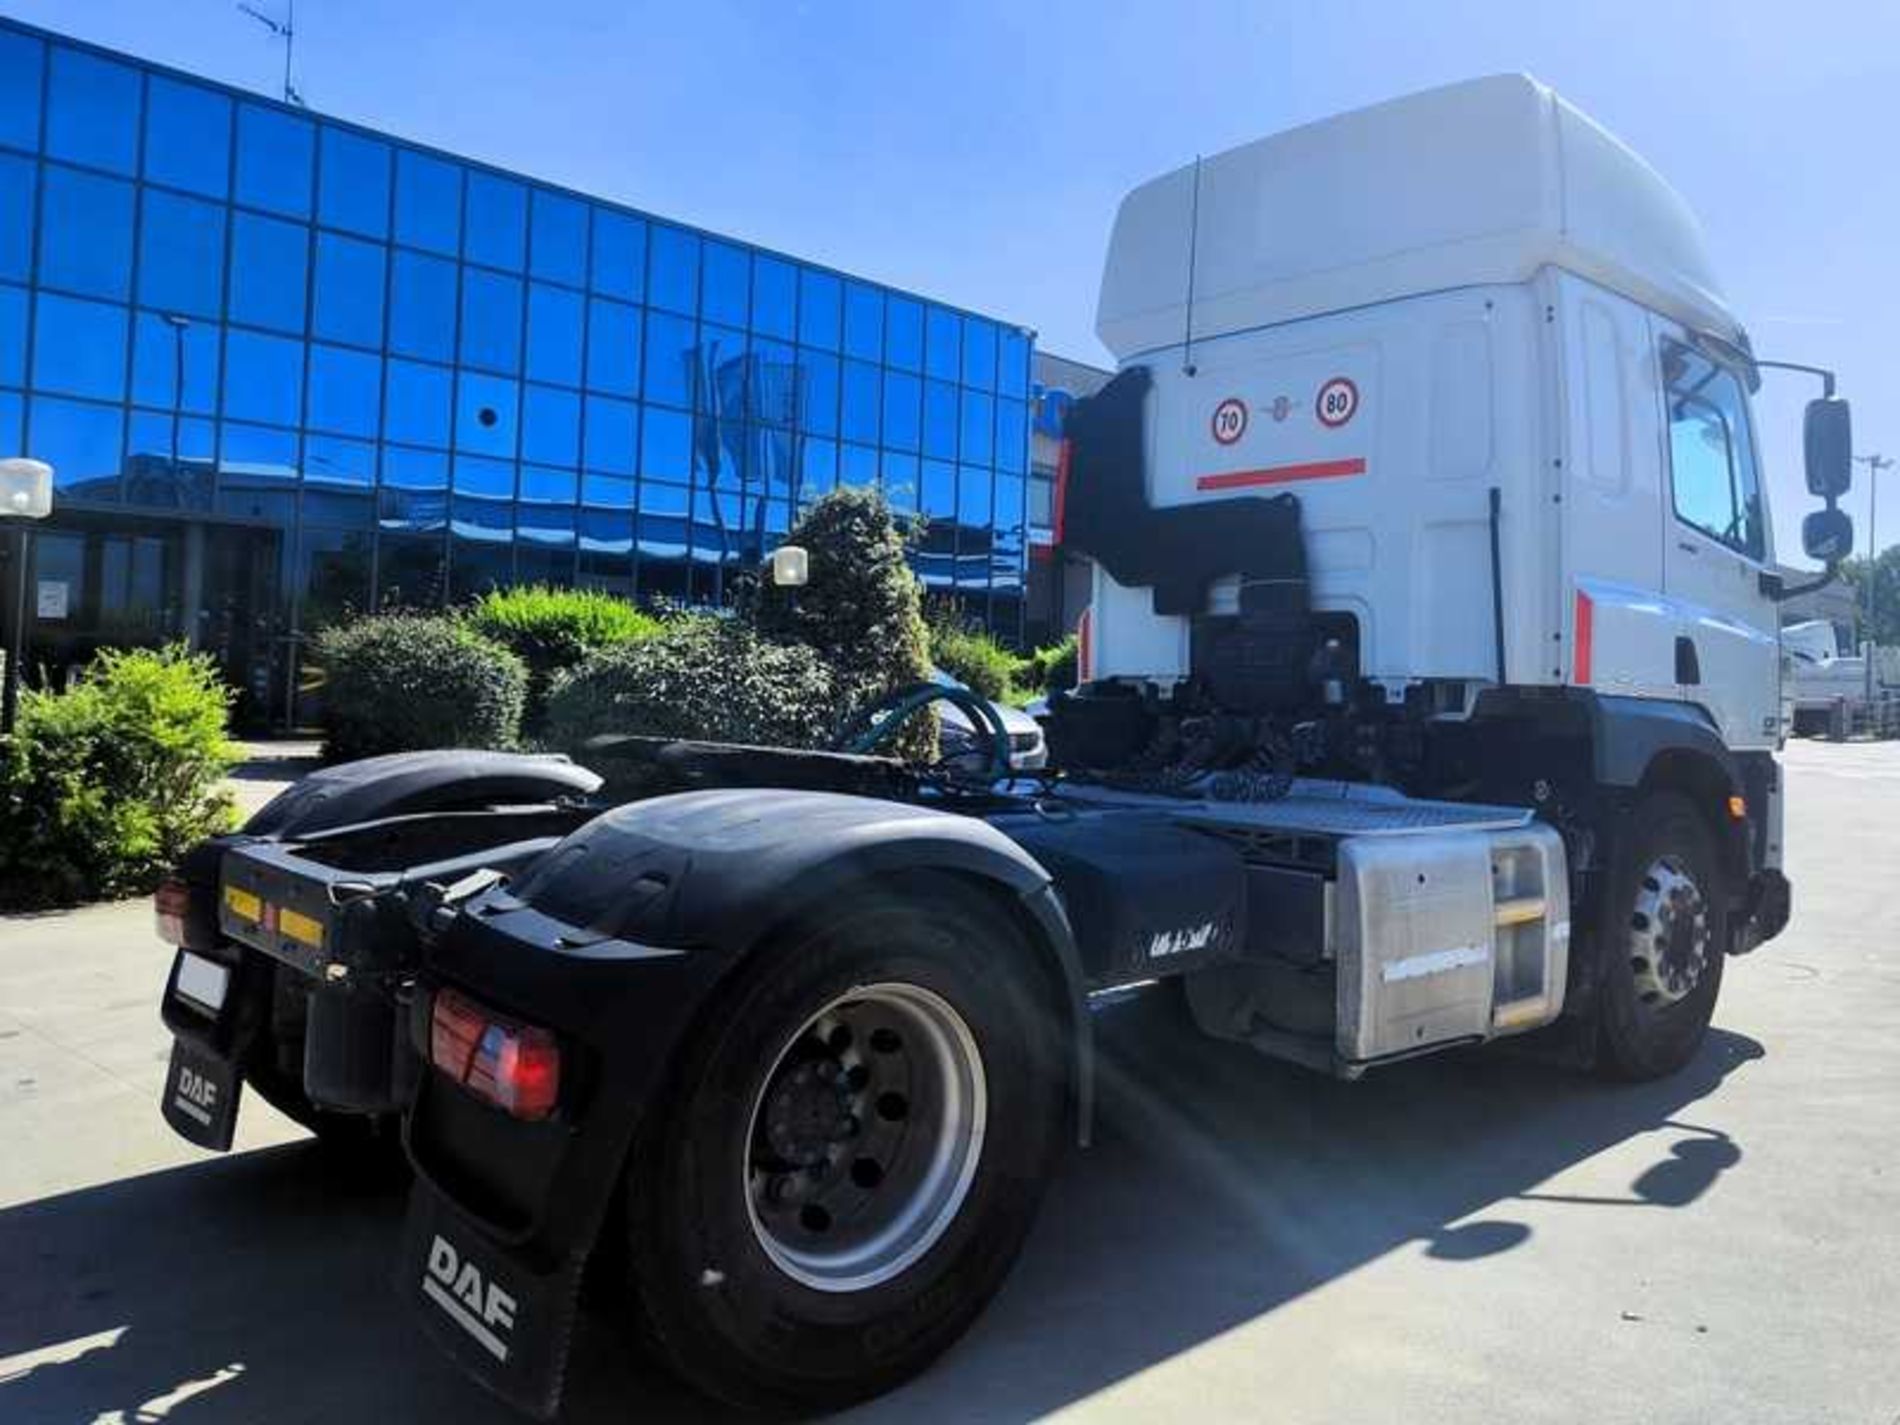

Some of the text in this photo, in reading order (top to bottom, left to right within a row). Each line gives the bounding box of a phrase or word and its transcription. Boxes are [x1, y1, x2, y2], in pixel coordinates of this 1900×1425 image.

[1327, 392, 1347, 413] 80
[1220, 411, 1238, 432] 70
[178, 1067, 217, 1107] DAF
[428, 1234, 517, 1329] DAF
